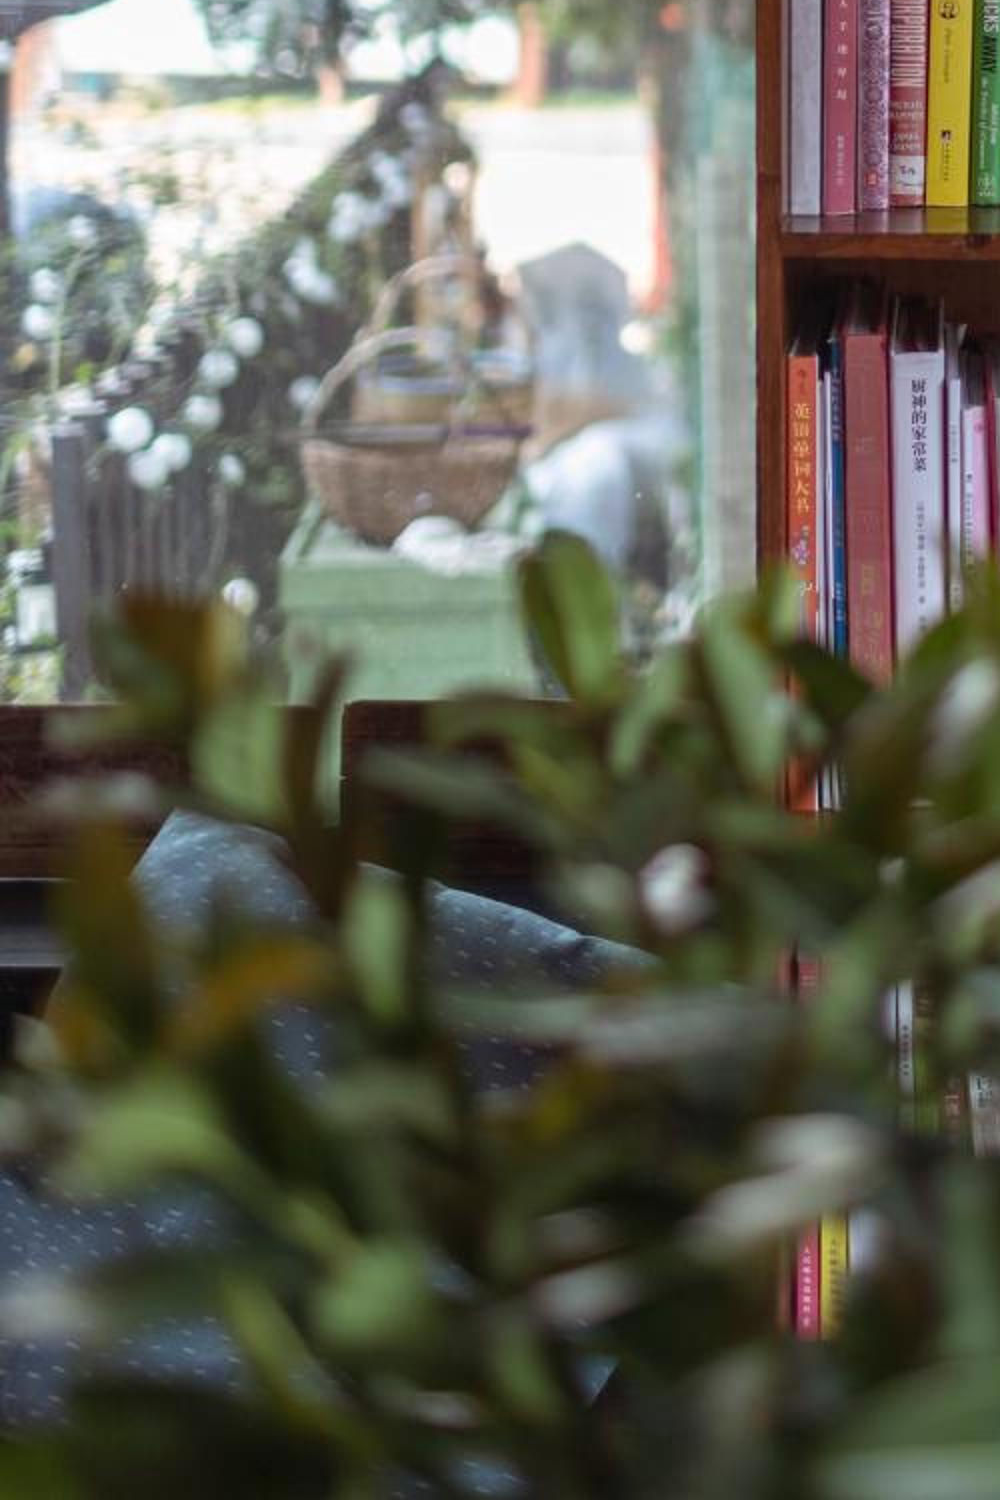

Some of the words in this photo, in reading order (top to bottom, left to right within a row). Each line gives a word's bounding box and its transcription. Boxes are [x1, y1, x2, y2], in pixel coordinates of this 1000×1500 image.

[982, 34, 996, 73] AWAY
[911, 378, 927, 472] 厨神的家常菜
